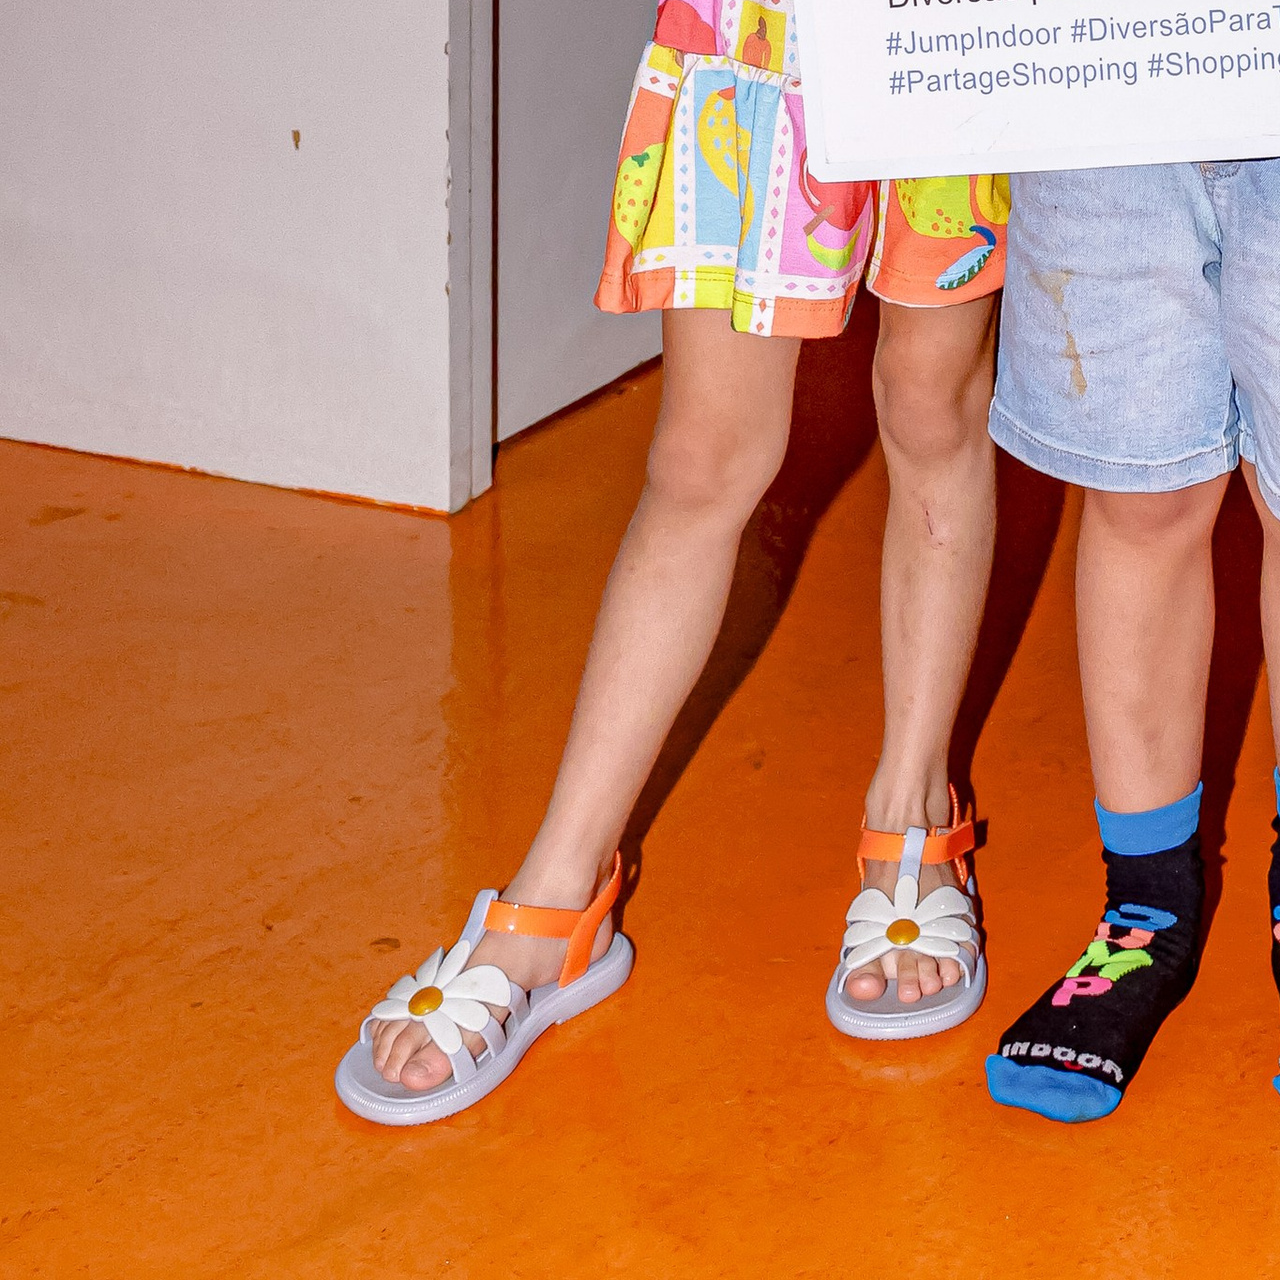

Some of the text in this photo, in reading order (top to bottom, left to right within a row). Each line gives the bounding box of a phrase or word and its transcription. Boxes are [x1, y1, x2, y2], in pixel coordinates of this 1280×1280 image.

[885, 23, 1062, 57] #JumpIndoor
[888, 57, 1138, 95] #PartageShopping
[1051, 902, 1178, 1007] JUMP
[1001, 1041, 1124, 1084] INDOOR
